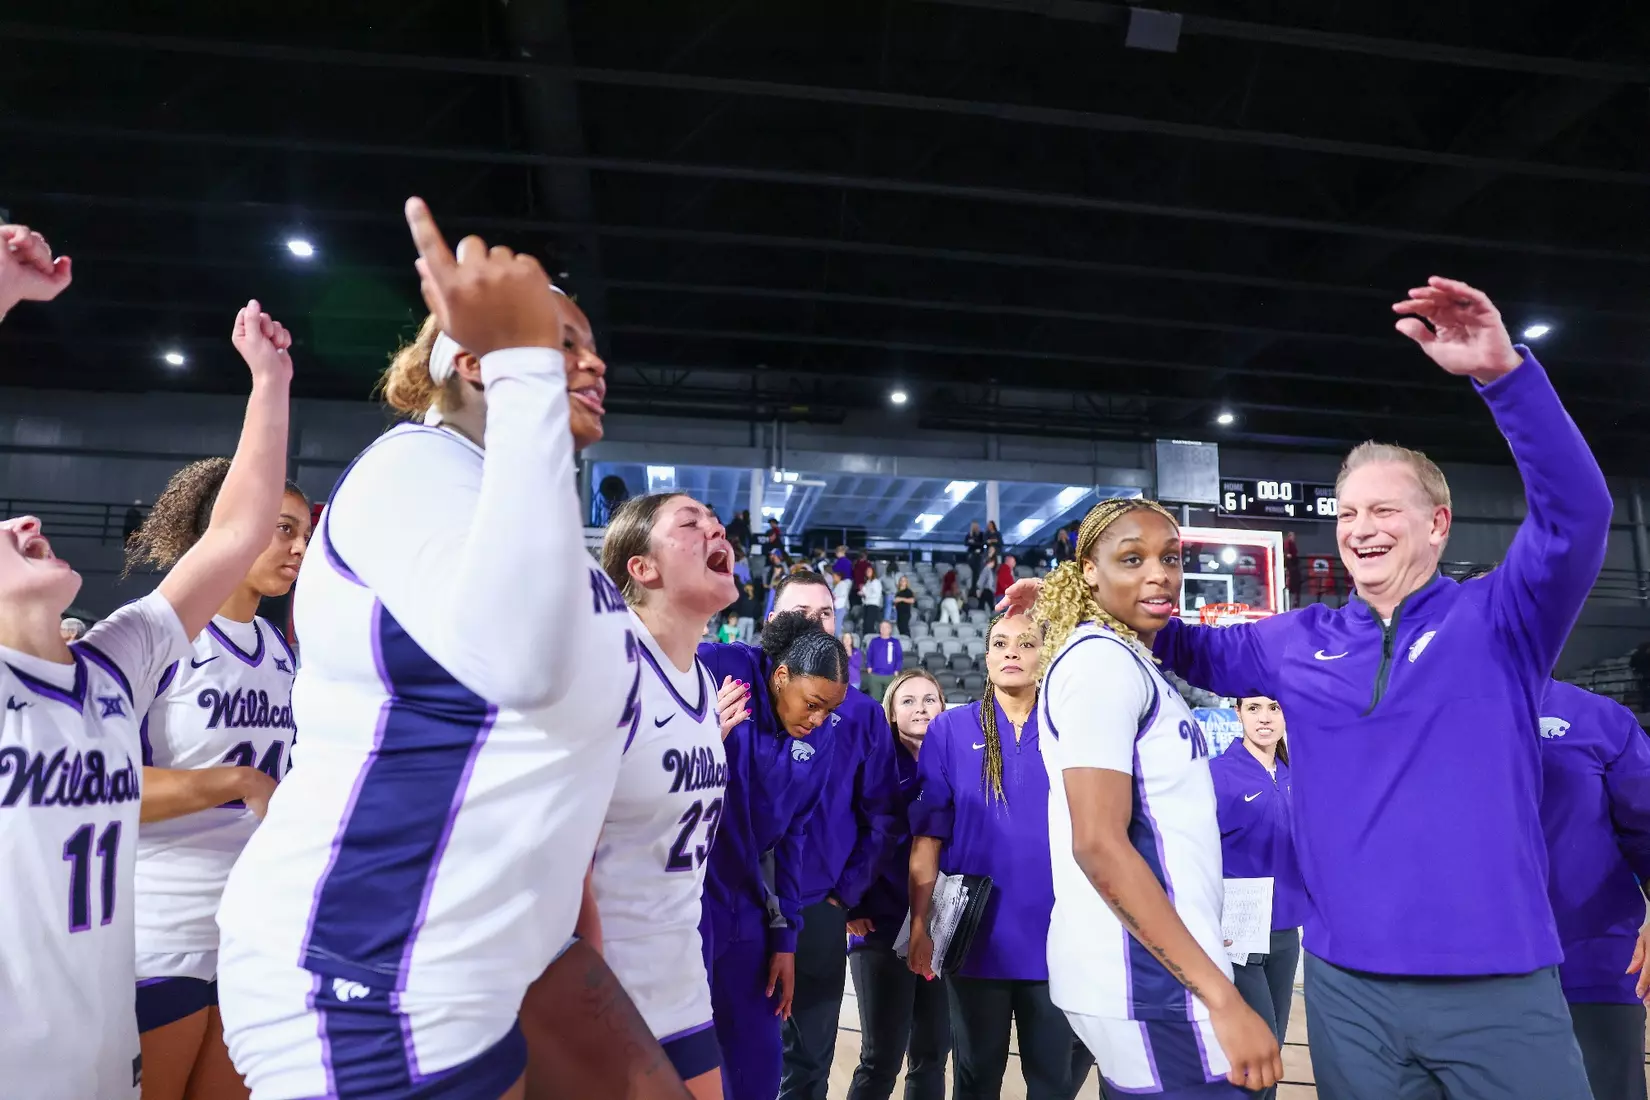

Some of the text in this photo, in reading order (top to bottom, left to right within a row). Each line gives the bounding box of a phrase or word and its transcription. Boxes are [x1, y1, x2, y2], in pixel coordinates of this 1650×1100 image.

[1223, 482, 1244, 492] HOME
[1257, 481, 1292, 501] 00.0
[1285, 503, 1294, 517] 4
[1317, 497, 1338, 516] 60
[197, 687, 294, 730] Wildca
[664, 797, 723, 873] 23
[63, 820, 122, 934] 11
